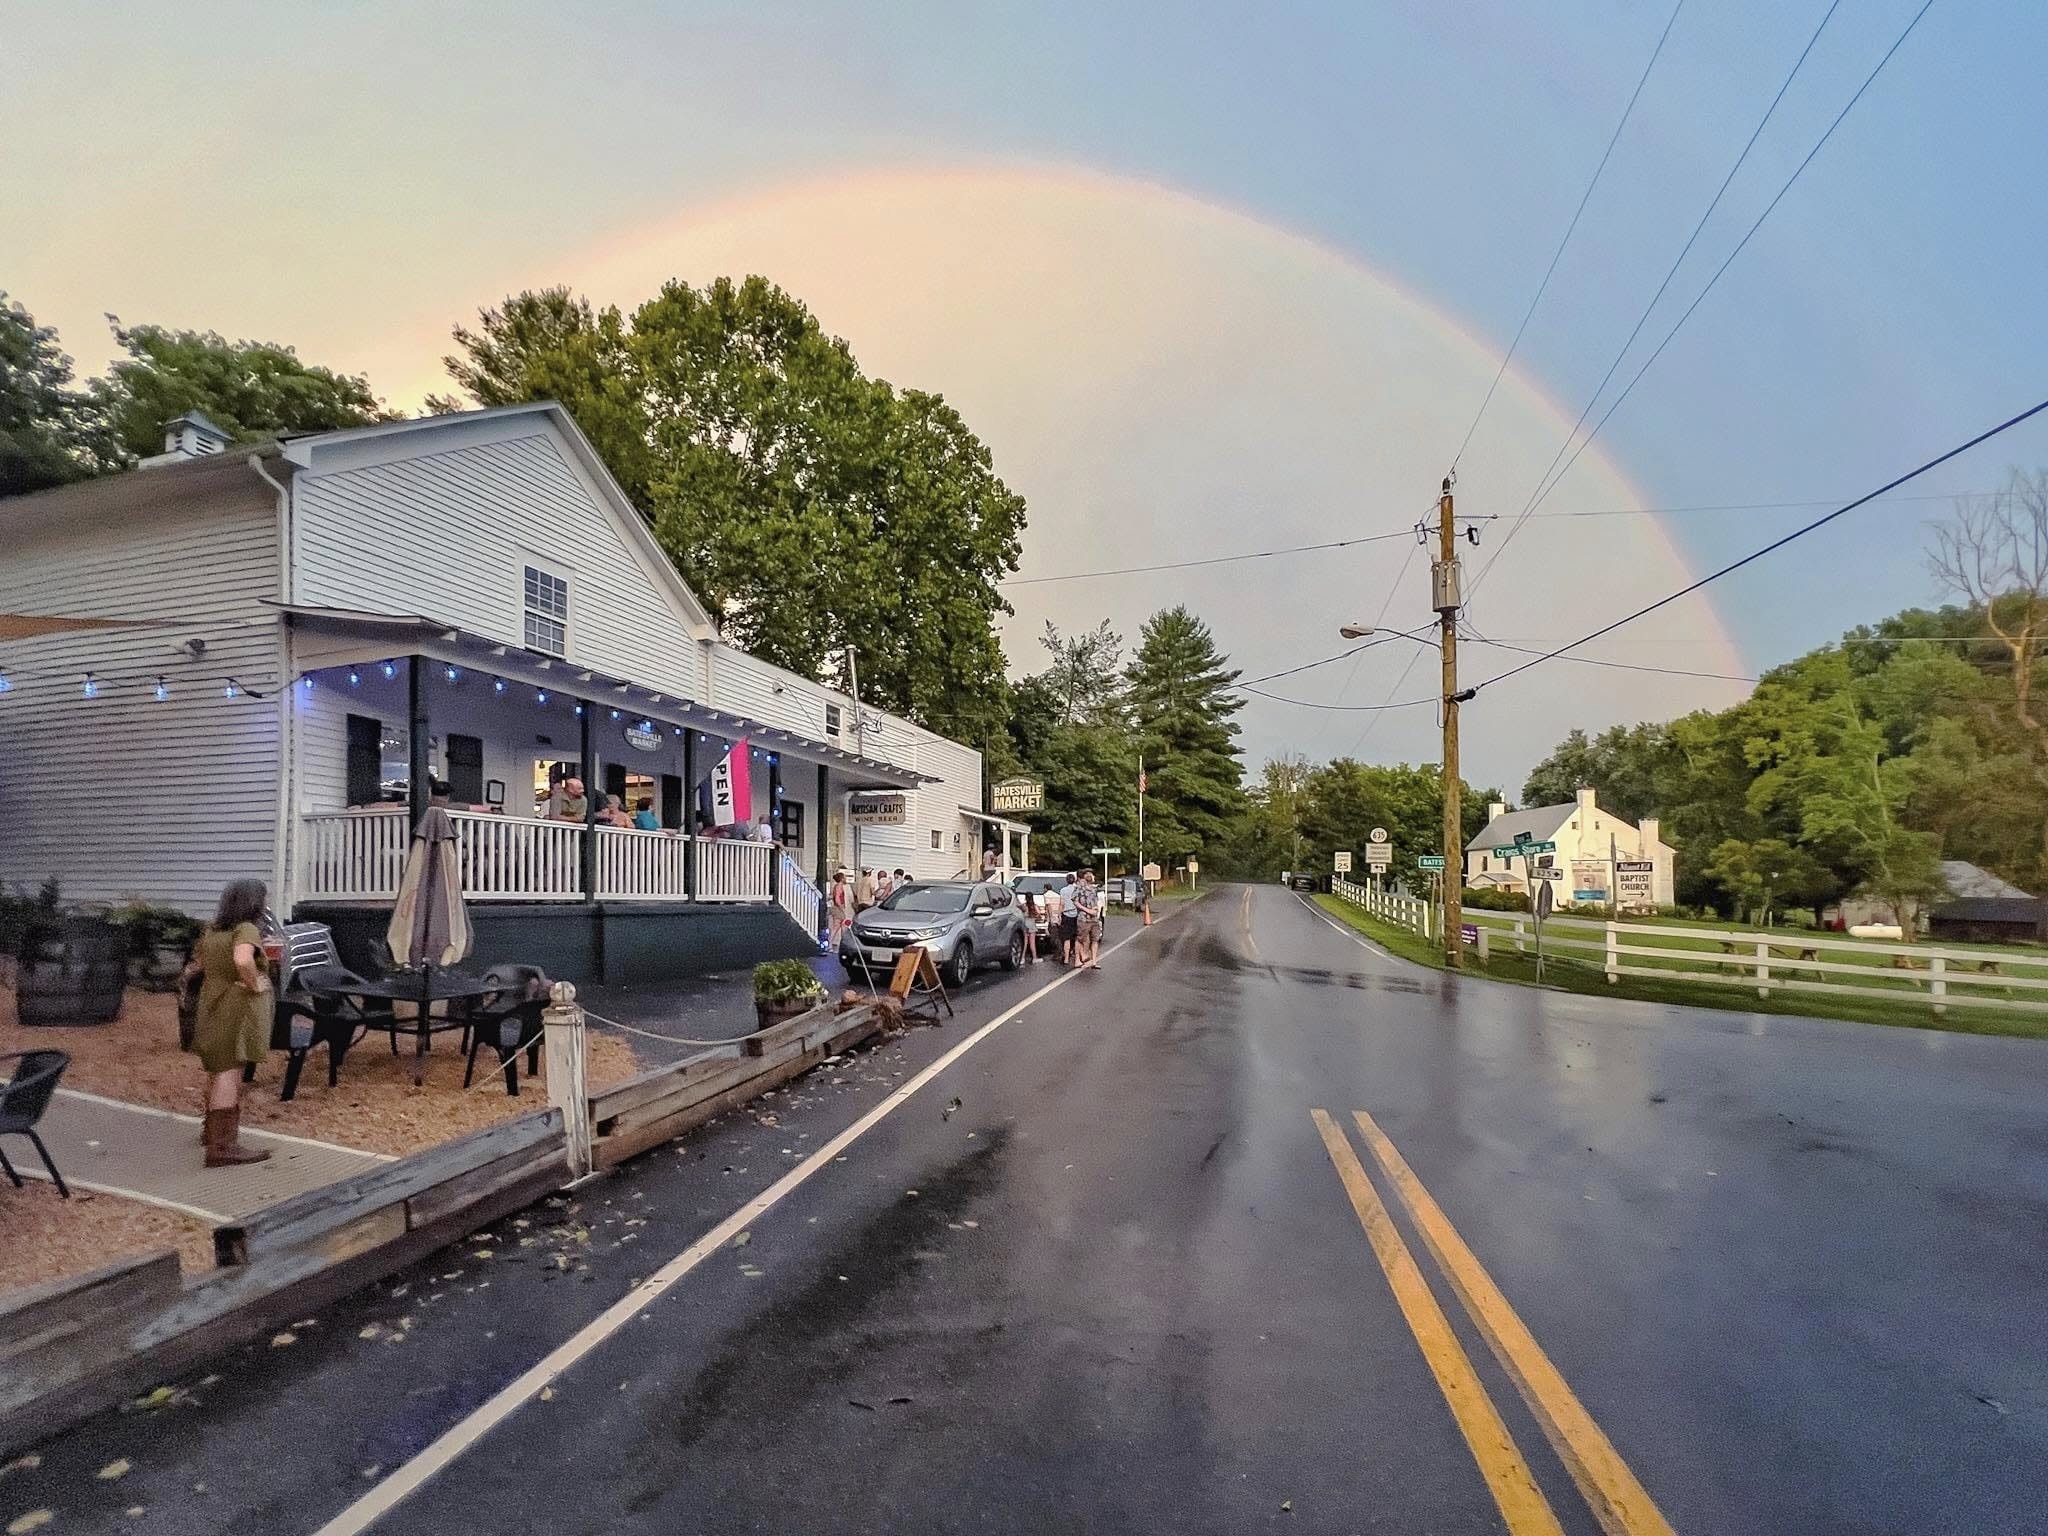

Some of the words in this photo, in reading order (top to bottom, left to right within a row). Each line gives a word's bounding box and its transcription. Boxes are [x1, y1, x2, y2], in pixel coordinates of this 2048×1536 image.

[632, 737, 657, 751] MARKET
[716, 763, 729, 806] PEN
[994, 785, 1041, 797] BATESVILLE
[994, 795, 1041, 809] MARKET
[1337, 862, 1349, 870] 25
[1620, 874, 1648, 882] BAPTIST
[1620, 883, 1649, 891] CHURCH
